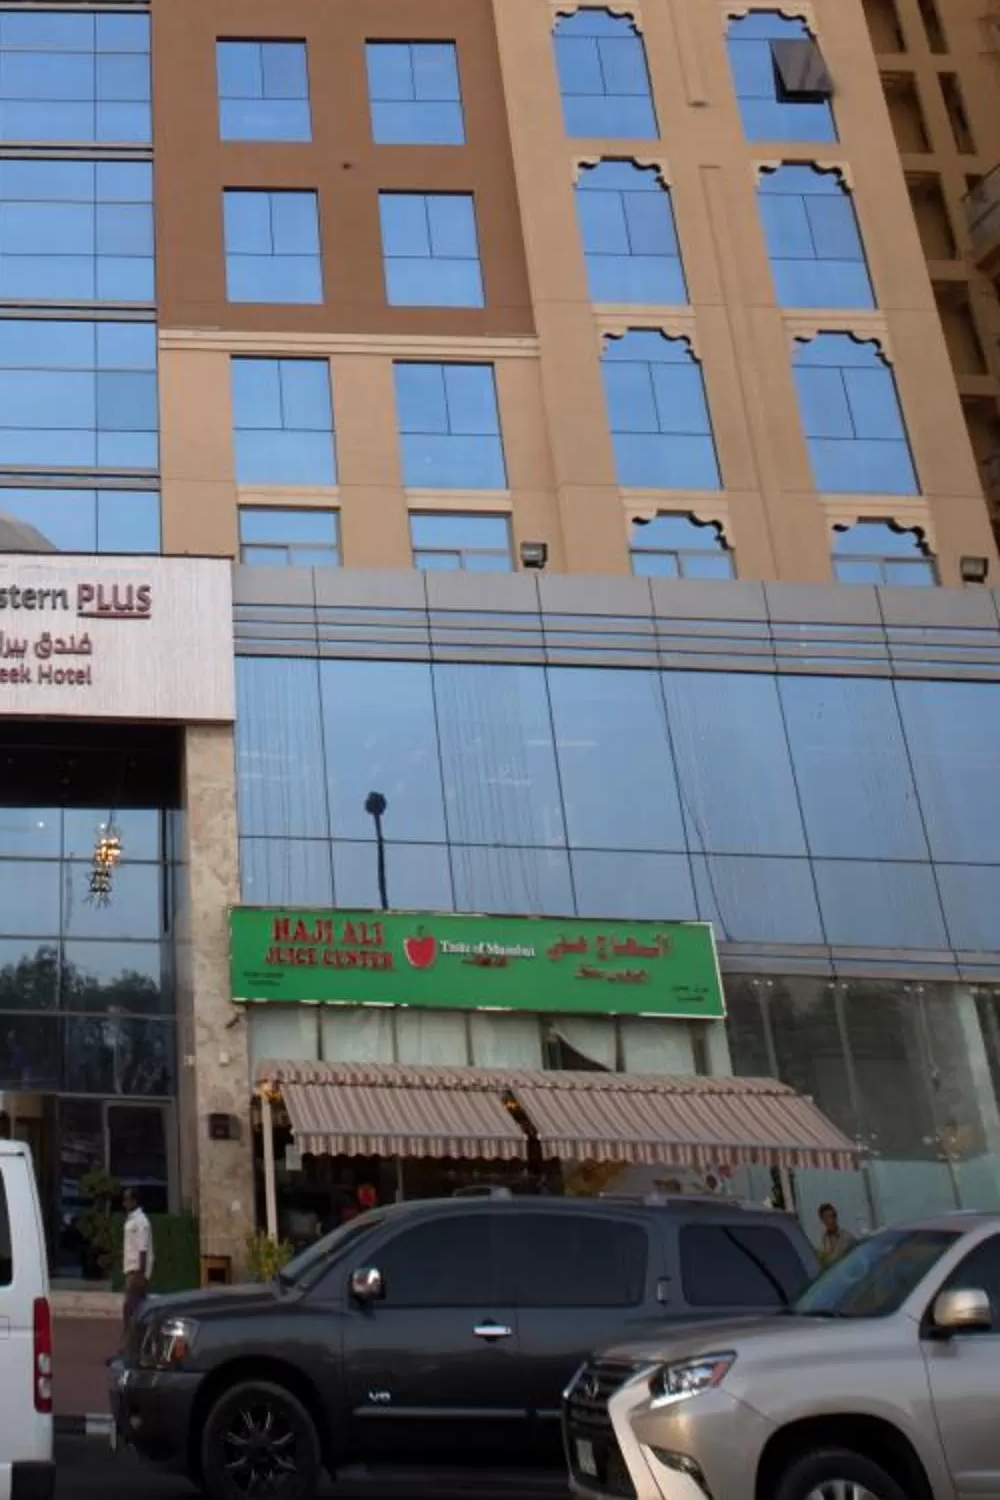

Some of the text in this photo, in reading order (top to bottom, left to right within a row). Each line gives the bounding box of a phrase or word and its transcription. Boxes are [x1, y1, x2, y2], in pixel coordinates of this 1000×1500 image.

[76, 584, 153, 614] PLUS
[33, 631, 93, 660] فندق
[37, 664, 93, 686] Hotel
[272, 917, 386, 946] HAJI ALI
[264, 946, 395, 971] JUICE CENTER
